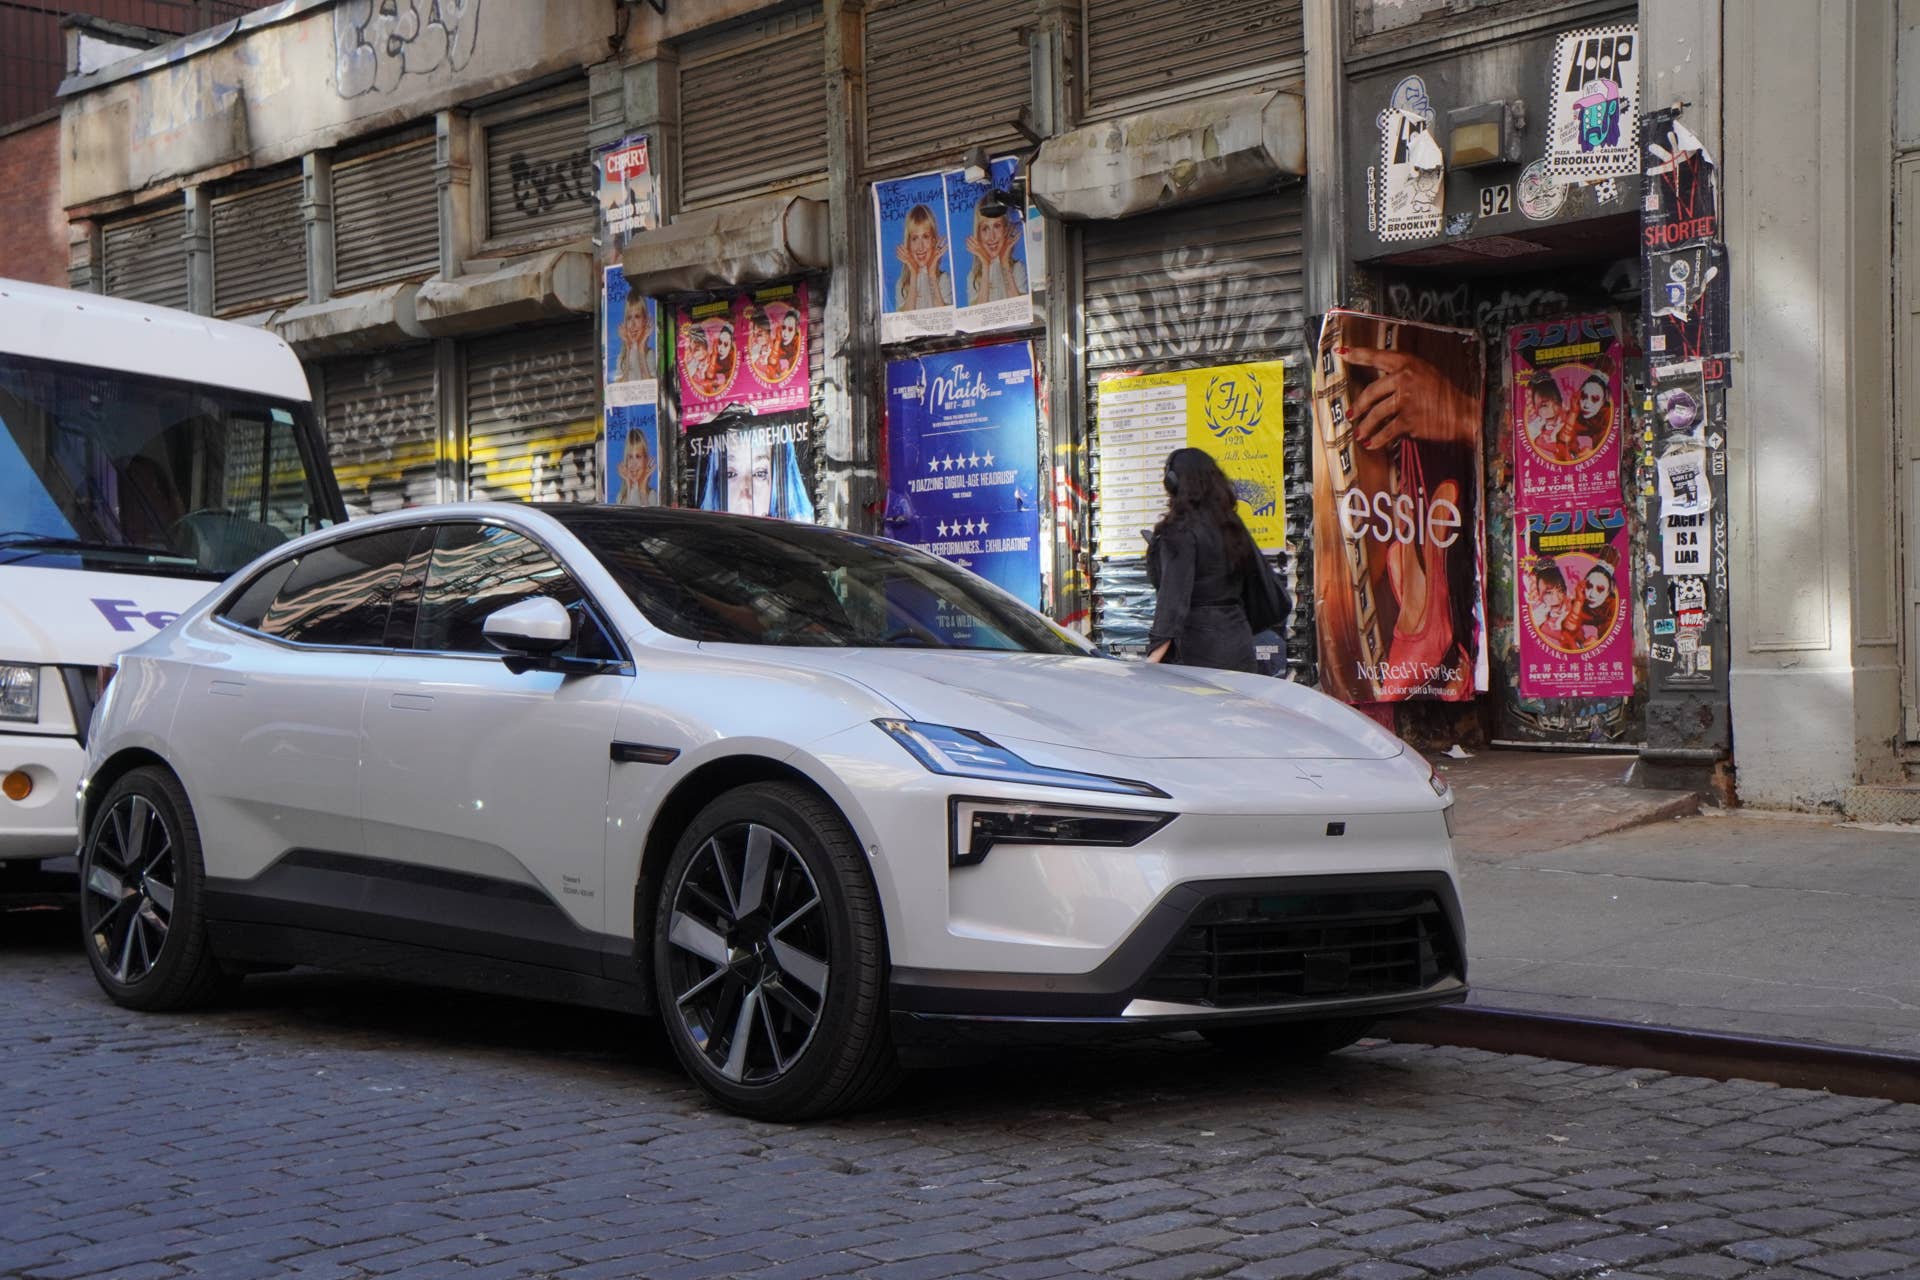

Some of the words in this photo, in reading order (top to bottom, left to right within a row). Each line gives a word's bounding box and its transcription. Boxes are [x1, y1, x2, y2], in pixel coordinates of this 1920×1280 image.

[607, 149, 646, 174] CHRRY
[1554, 155, 1609, 165] BROOKLYN
[1613, 154, 1627, 163] NY
[1482, 187, 1509, 215] 92
[1388, 220, 1437, 232] BROOKLYN
[951, 364, 971, 388] The
[930, 371, 990, 415] Maids
[1331, 403, 1342, 423] 15
[690, 438, 705, 456] ST.
[739, 421, 809, 450] WAREHOUSE
[1523, 486, 1546, 494] NEW
[1547, 483, 1575, 492] YORK
[1340, 486, 1462, 548] essie
[1668, 514, 1698, 528] ZACH
[1677, 532, 1688, 545] IS
[1689, 531, 1698, 545] A
[1675, 551, 1699, 564] LIAR
[1356, 660, 1379, 680] Not
[1379, 660, 1420, 680] Red-Y
[1420, 662, 1441, 681] For
[1529, 672, 1552, 680] NEW
[1553, 671, 1580, 680] YORK
